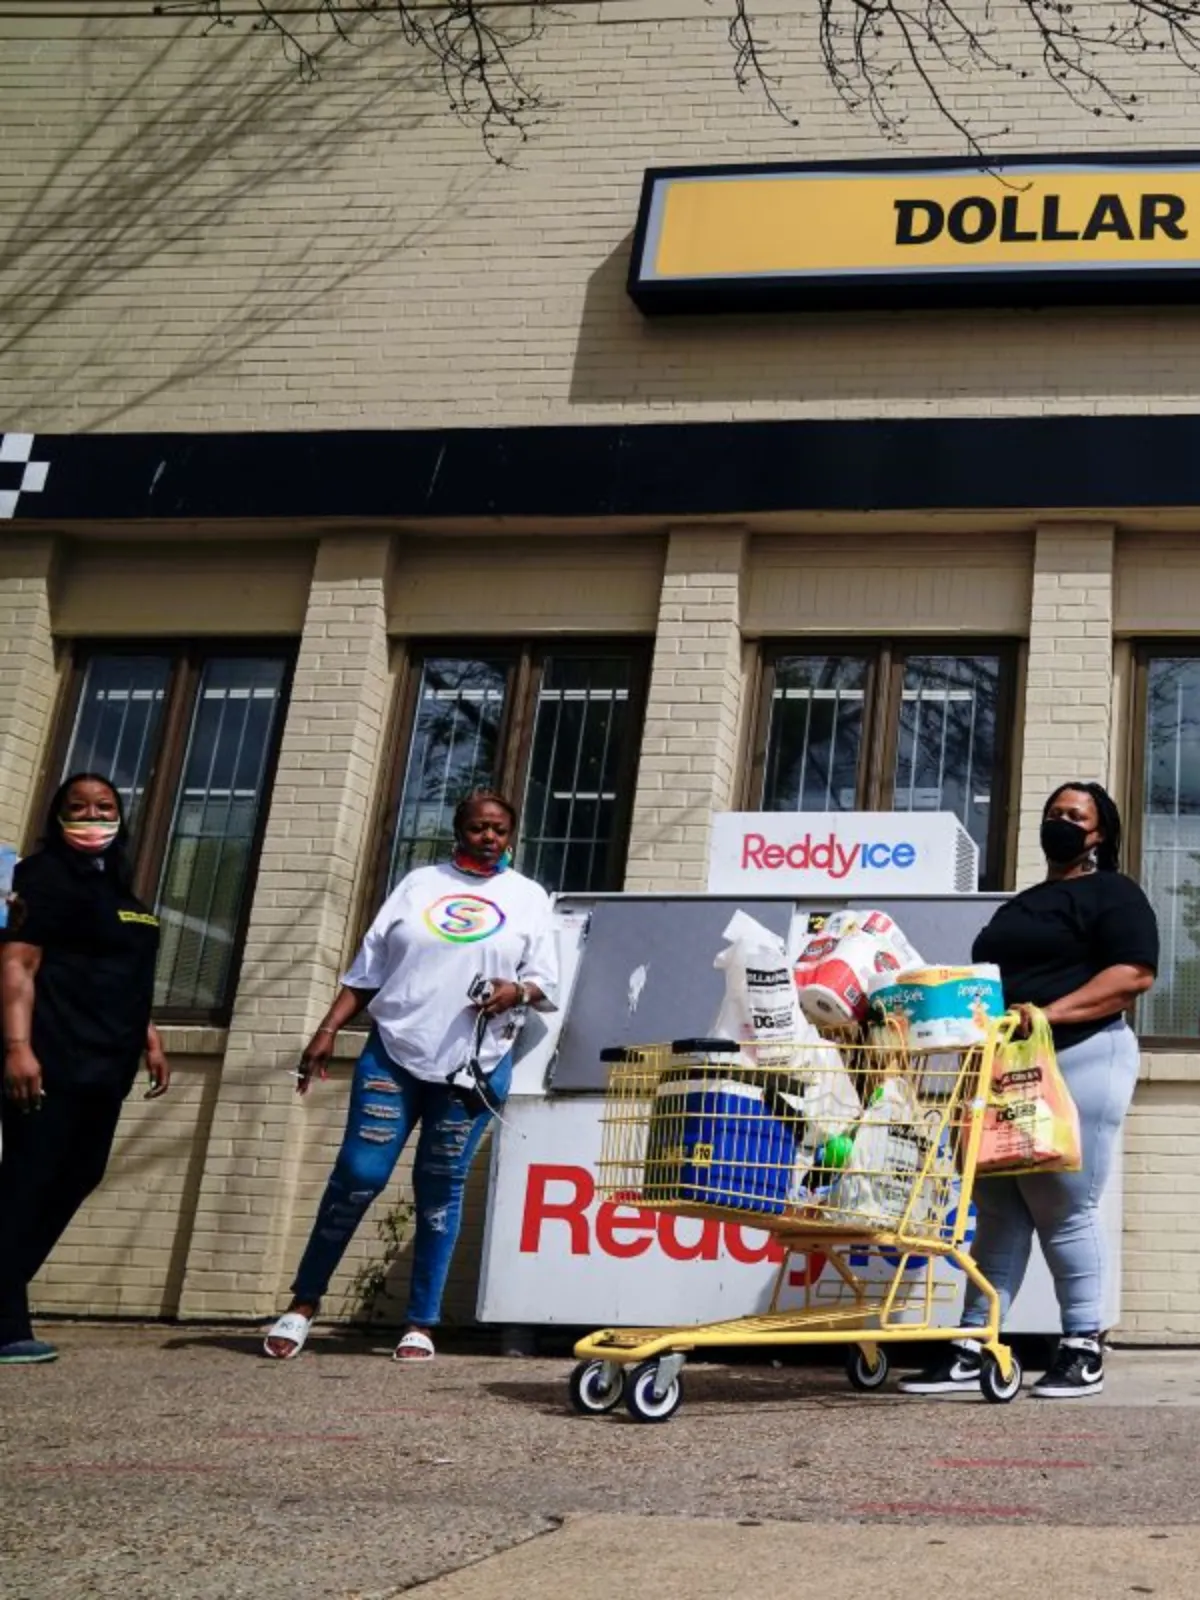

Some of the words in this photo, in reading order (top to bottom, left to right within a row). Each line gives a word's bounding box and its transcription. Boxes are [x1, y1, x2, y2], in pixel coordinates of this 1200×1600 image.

[894, 194, 1188, 245] DOLLAR
[441, 901, 487, 934] S
[752, 1015, 775, 1029] DG
[996, 1105, 1015, 1123] DG
